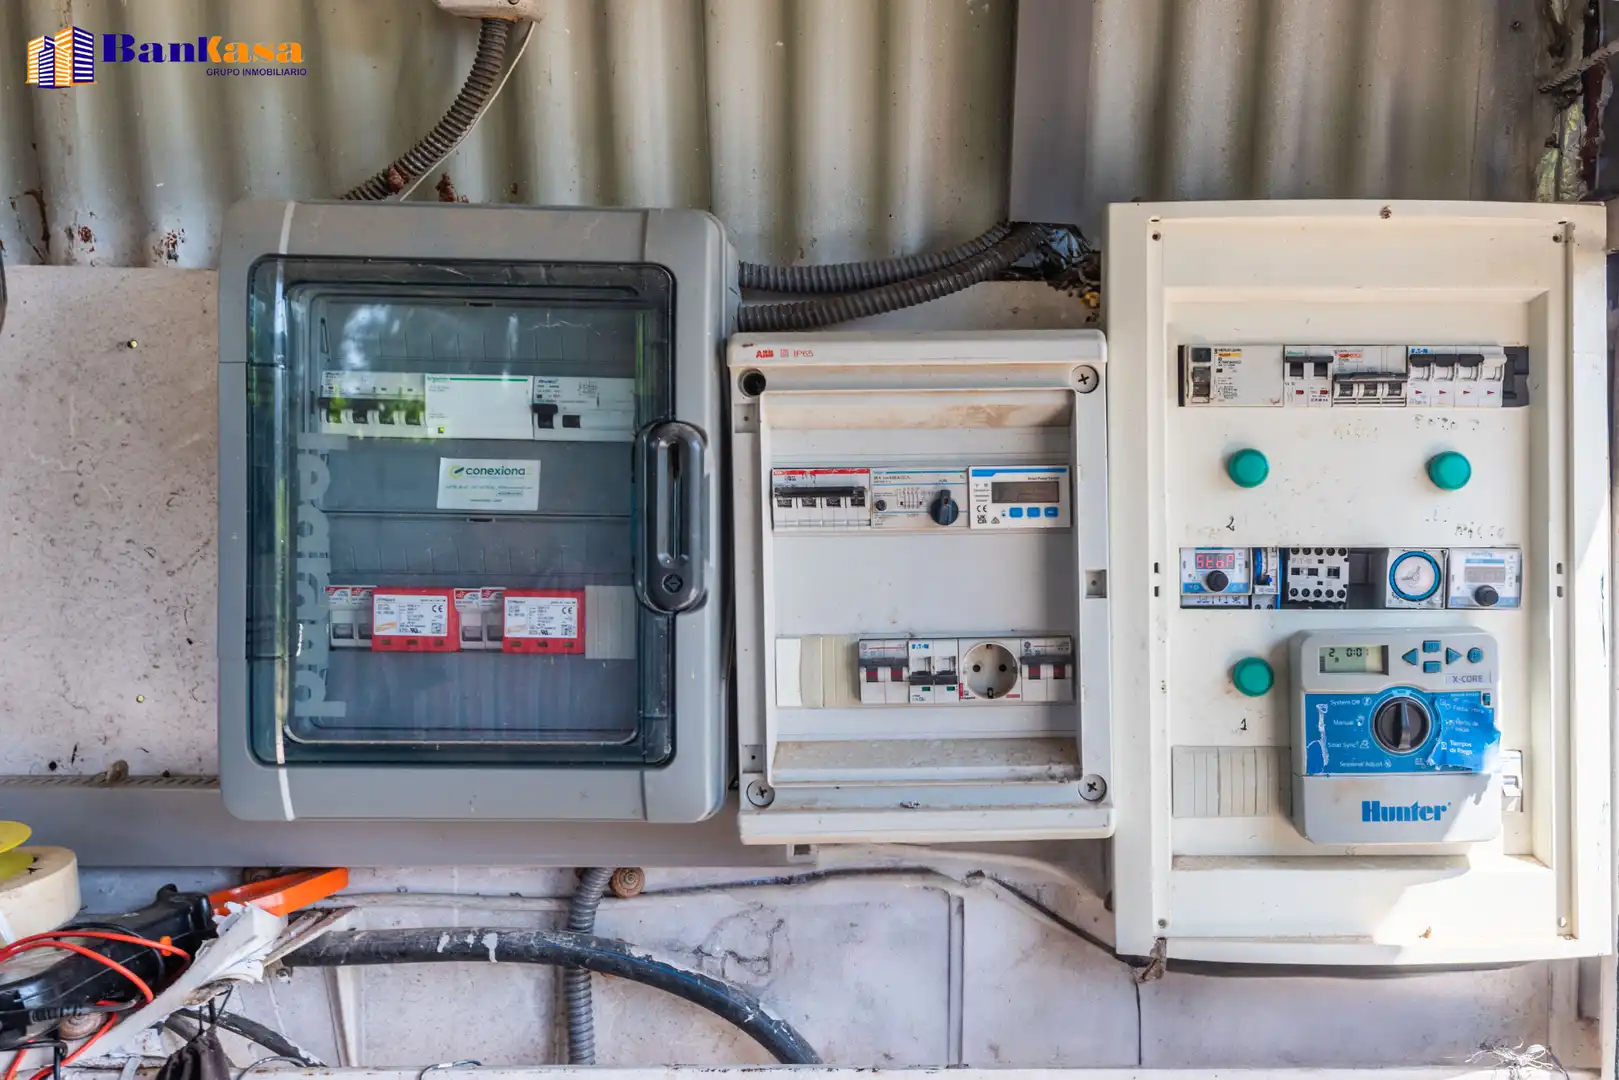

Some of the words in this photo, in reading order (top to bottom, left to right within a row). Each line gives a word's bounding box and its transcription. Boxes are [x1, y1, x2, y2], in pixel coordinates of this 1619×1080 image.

[756, 350, 774, 358] ABB
[793, 349, 814, 357] IP65
[465, 465, 526, 476] conexiona
[1452, 675, 1483, 683] X-CORE
[1240, 718, 1247, 731] 1
[1361, 800, 1447, 822] Hunter
